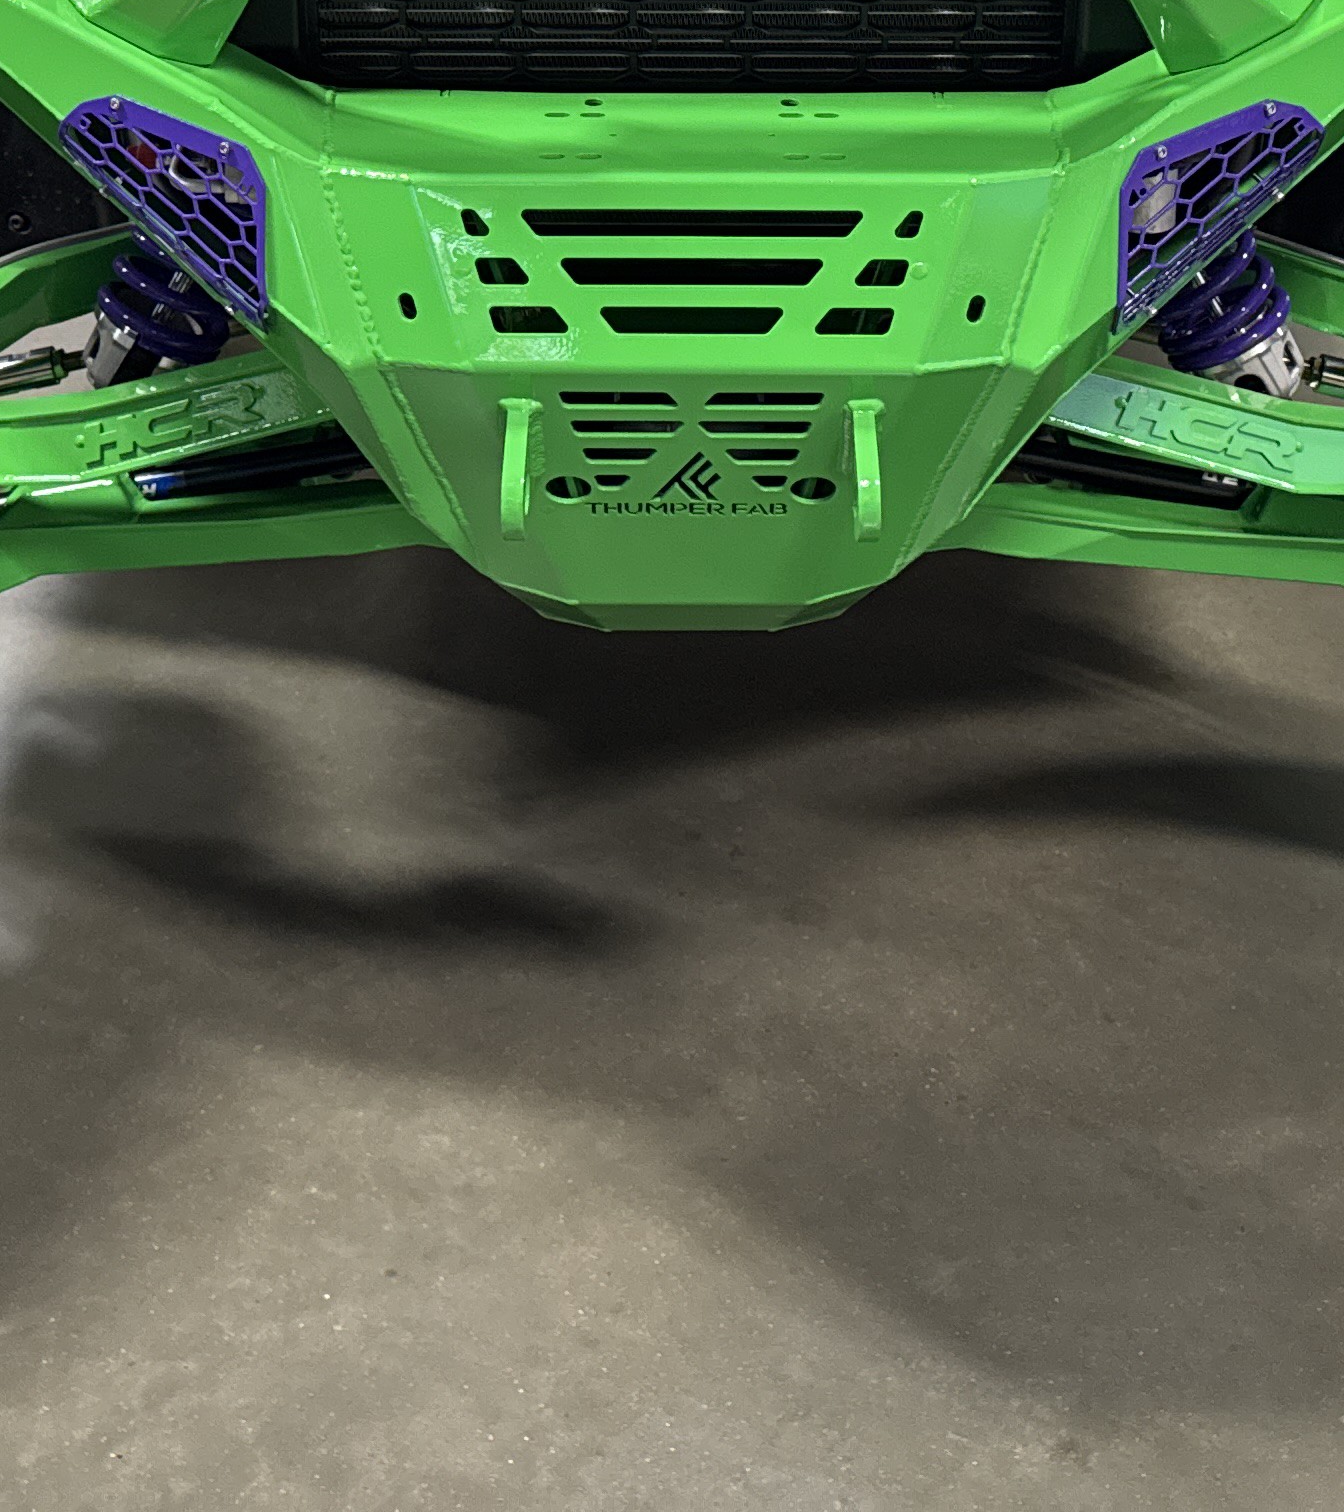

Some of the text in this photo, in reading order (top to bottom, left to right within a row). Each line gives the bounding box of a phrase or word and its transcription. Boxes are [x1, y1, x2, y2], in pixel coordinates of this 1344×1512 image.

[82, 384, 265, 469] HCR
[1116, 388, 1304, 473] HCR
[586, 501, 788, 515] THUMPER FAB
